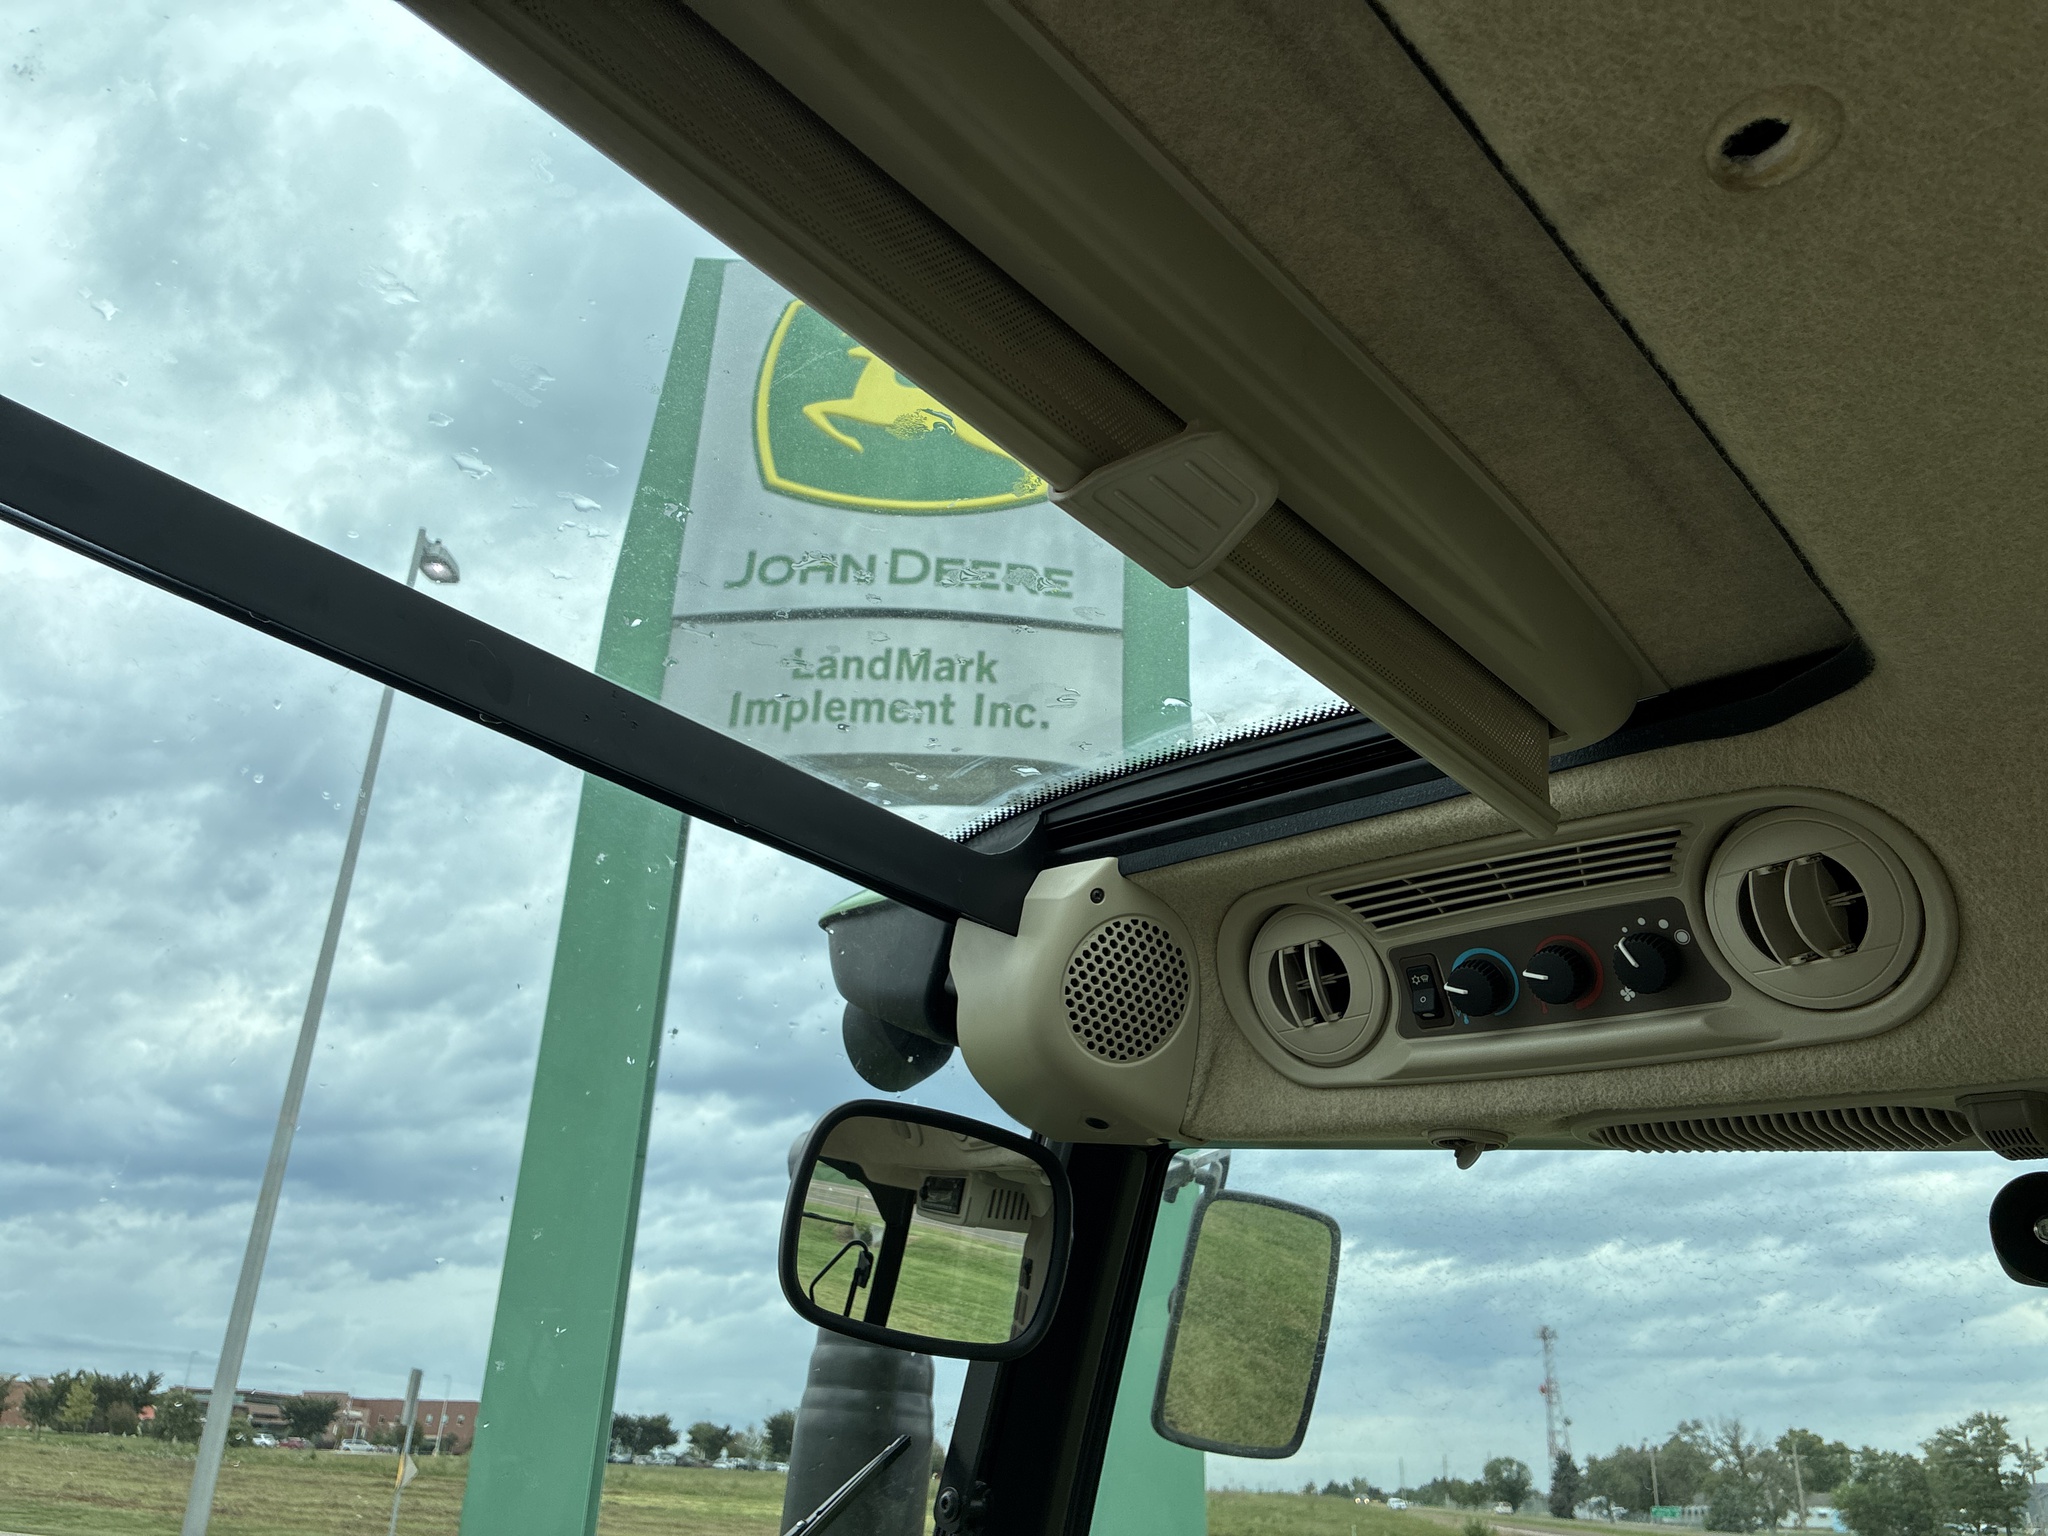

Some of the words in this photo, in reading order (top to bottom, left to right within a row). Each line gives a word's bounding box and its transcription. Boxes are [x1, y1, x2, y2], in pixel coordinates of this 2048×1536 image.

[723, 549, 878, 590] JOHN
[888, 548, 1074, 598] DEERE
[791, 647, 998, 686] LandMark
[728, 690, 955, 733] Implement
[974, 693, 1050, 731] Inc.
